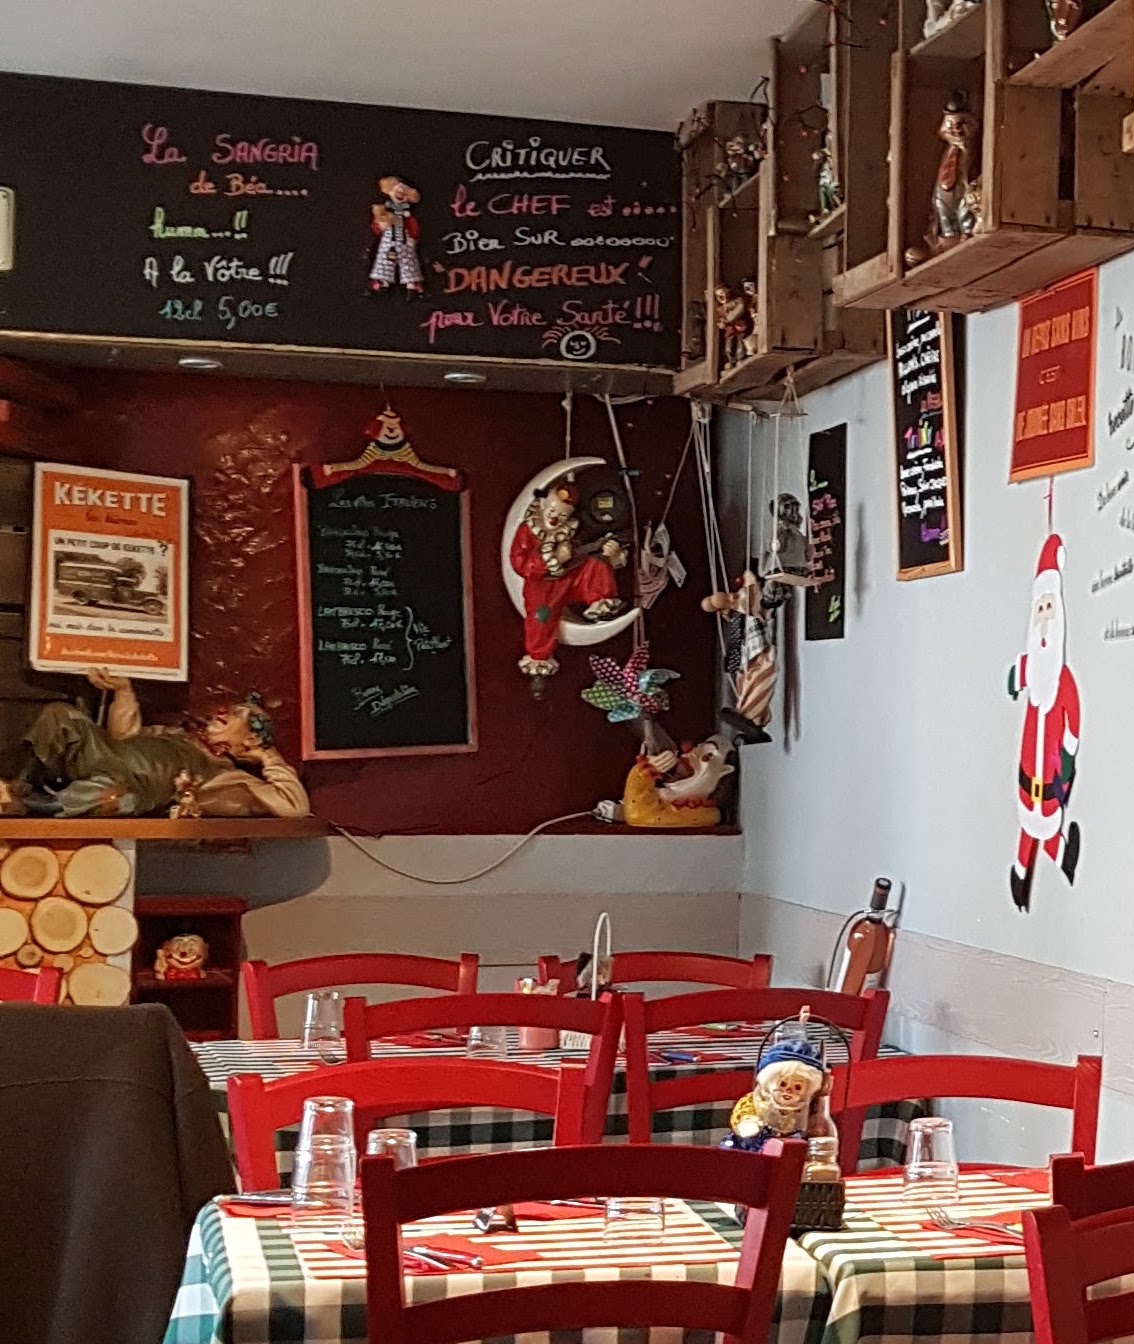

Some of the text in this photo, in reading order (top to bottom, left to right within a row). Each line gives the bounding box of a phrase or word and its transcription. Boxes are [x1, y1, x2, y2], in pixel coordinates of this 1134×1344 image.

[189, 170, 217, 194] de
[487, 193, 571, 215] CHEF
[143, 257, 159, 288] A
[169, 255, 195, 283] la
[54, 481, 167, 516] KEKETTE
